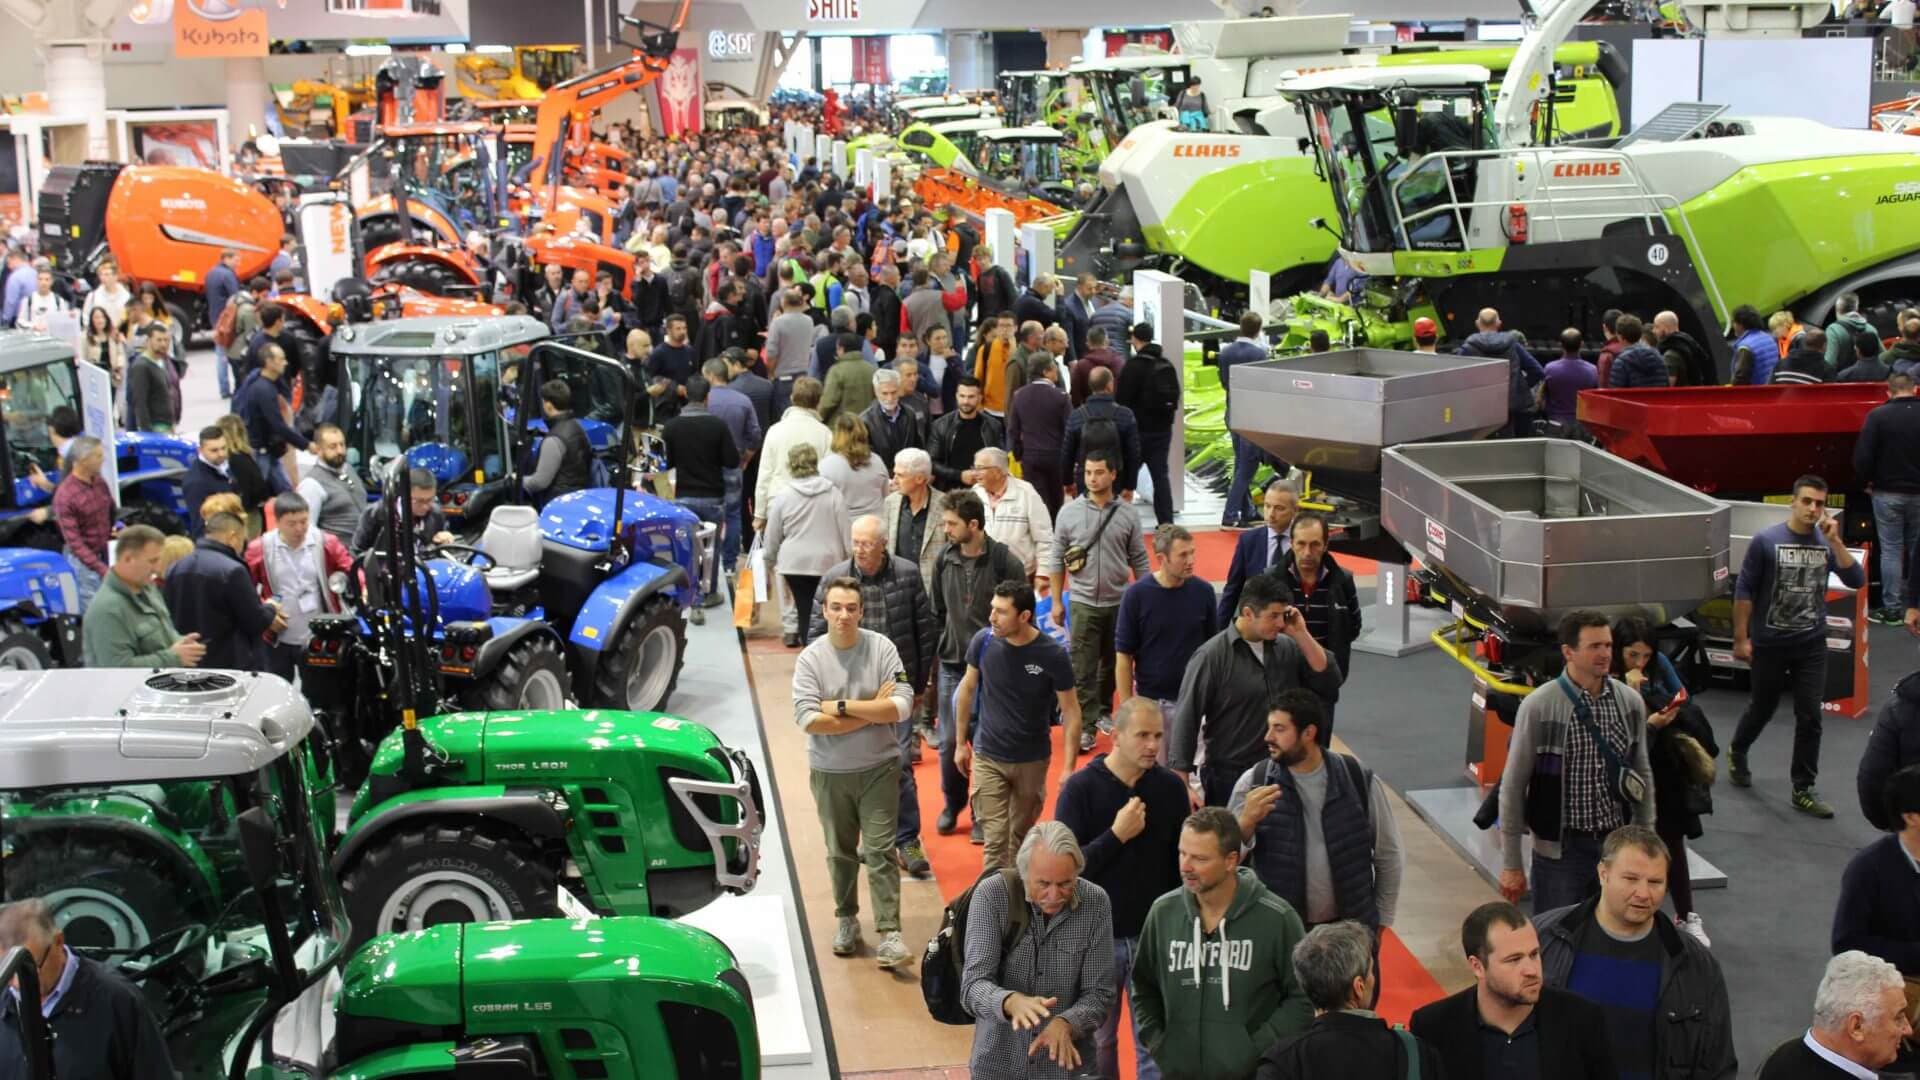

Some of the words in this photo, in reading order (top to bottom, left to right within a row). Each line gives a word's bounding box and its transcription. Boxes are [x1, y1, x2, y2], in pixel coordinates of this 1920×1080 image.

[183, 27, 259, 45] Kubota
[1173, 144, 1241, 158] CLAAS
[1553, 162, 1621, 177] CLAAS
[330, 203, 345, 254] NEW
[1651, 248, 1665, 261] 40
[1168, 939, 1253, 972] STANFORD
[472, 1003, 518, 1012] COBRAM
